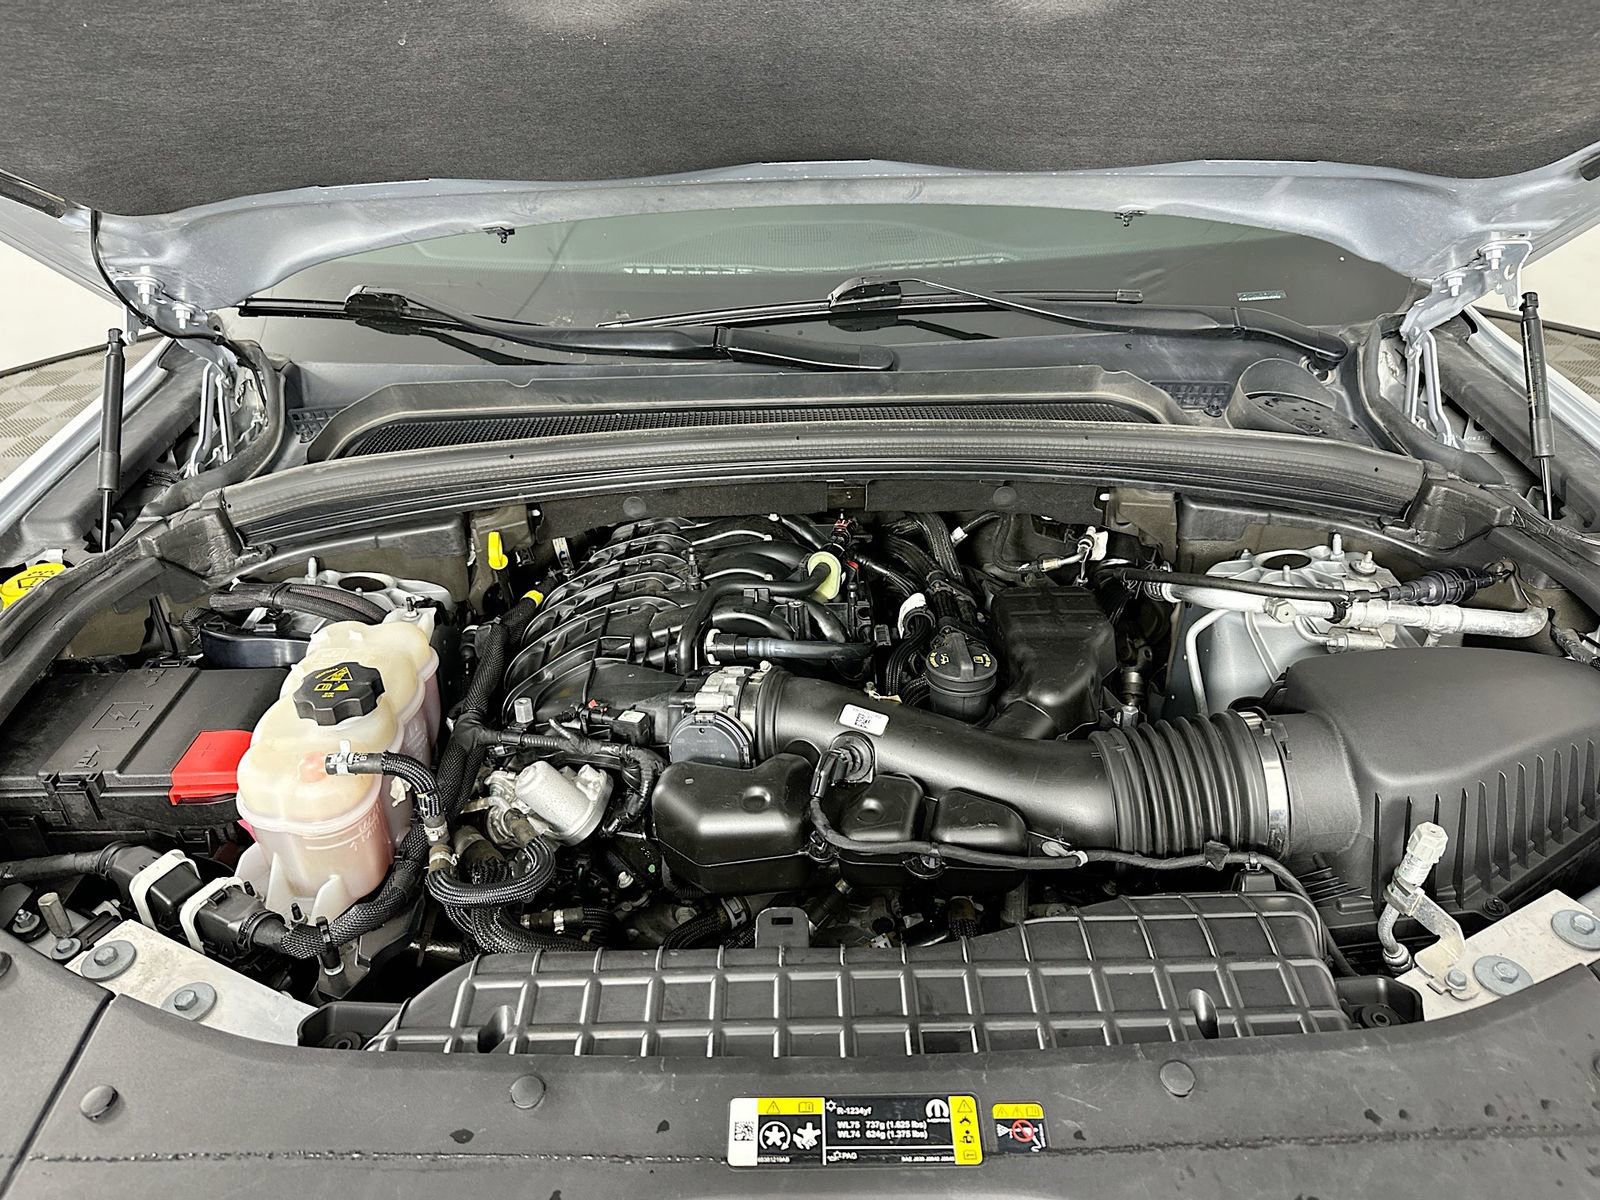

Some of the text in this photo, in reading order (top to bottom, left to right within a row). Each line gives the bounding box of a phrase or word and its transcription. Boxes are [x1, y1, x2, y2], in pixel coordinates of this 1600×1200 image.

[836, 1106, 872, 1117] R-1234yf
[836, 1120, 928, 1130] WL75 737g (1.625 lbs)
[836, 1130, 928, 1140] WL74 624g (1.375 lbs)
[841, 1152, 858, 1160] PAG
